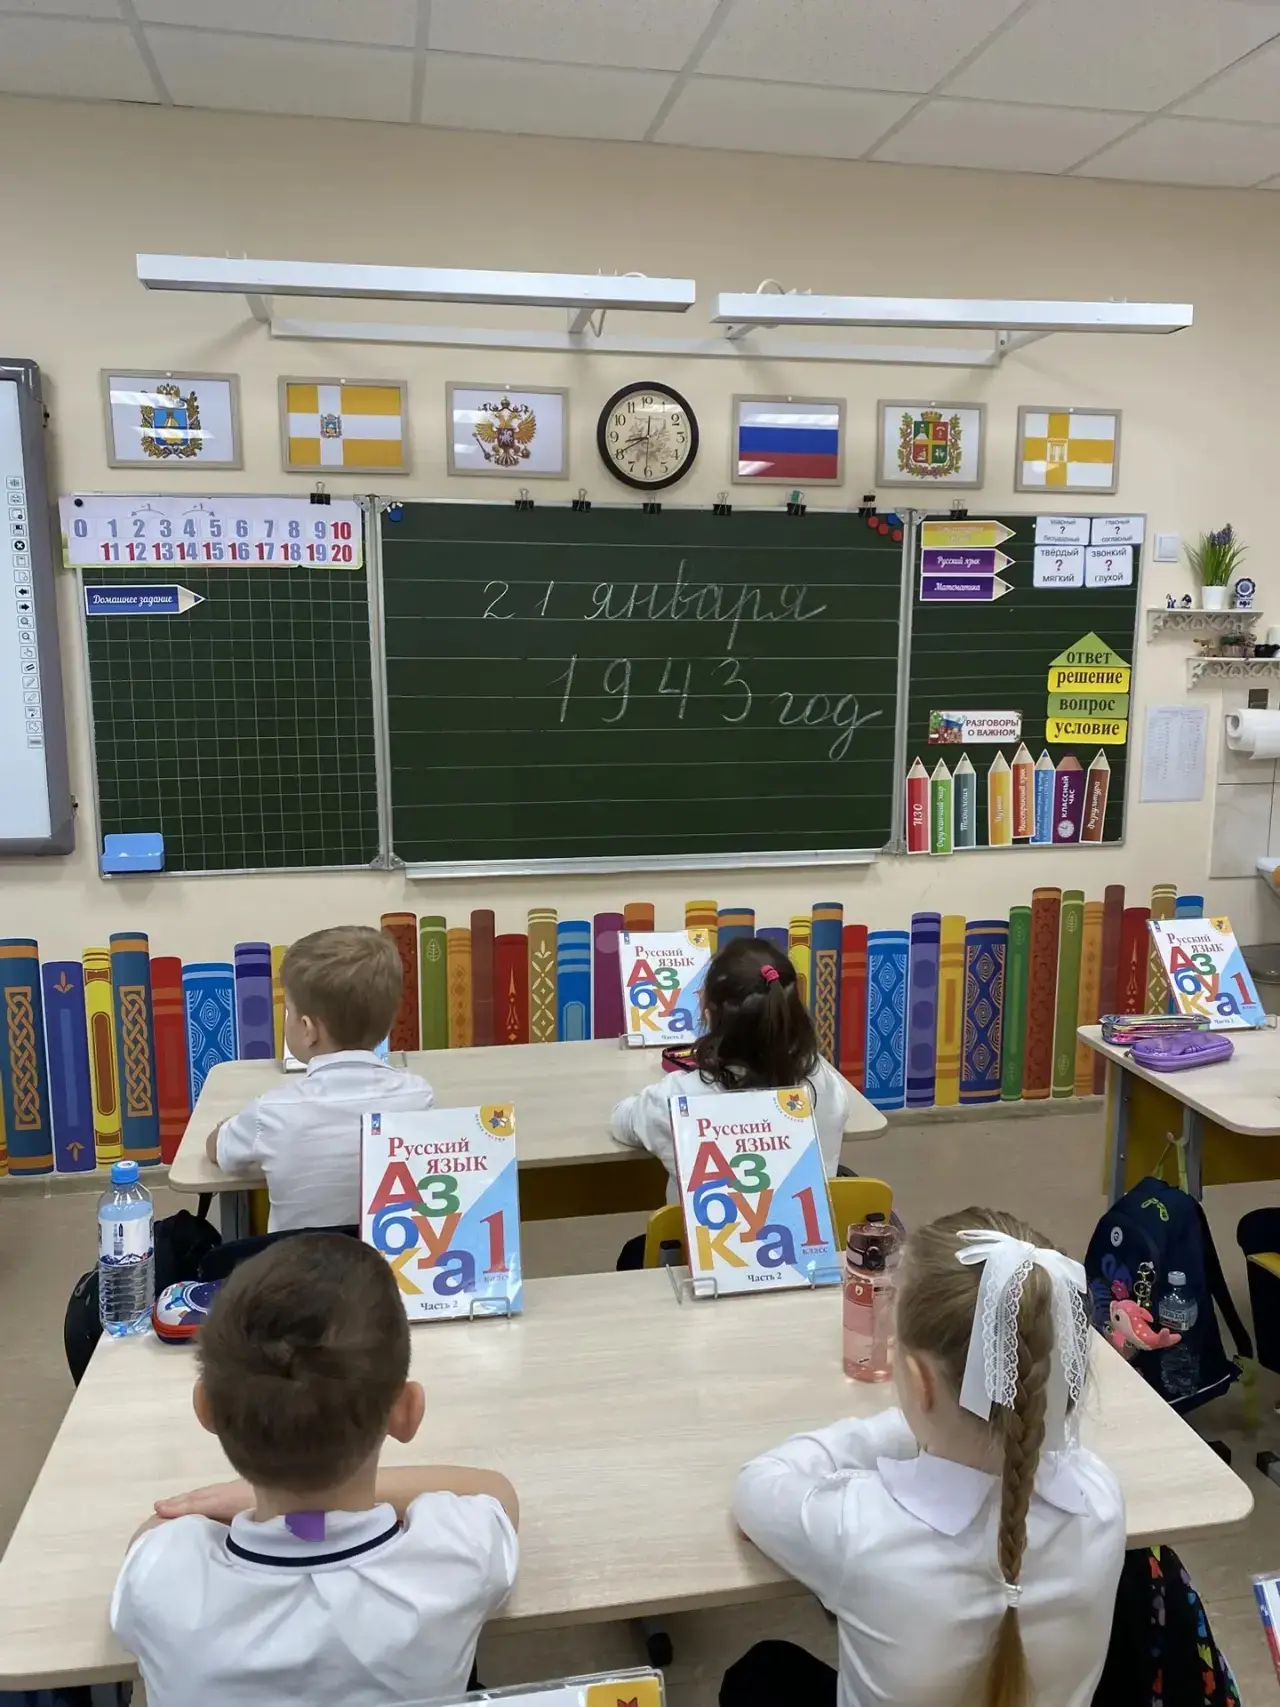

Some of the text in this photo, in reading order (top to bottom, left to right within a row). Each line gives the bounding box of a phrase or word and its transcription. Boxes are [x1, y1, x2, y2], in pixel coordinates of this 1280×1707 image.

[627, 401, 635, 413] 11
[615, 414, 626, 426] 10
[671, 413, 680, 426] 2
[609, 431, 619, 443] 9
[615, 448, 625, 460] 8
[628, 461, 636, 472] 7
[643, 465, 653, 477] 6
[660, 461, 669, 473] 5
[74, 518, 352, 540] 0 1 2 3 4 5 6 7 8 9 10
[100, 542, 353, 562] 11 12 13 14 15 16 17 18 19 20
[1091, 548, 1127, 557] звонкий
[937, 555, 964, 568] Русский
[1055, 559, 1063, 571] ?
[1105, 559, 1113, 571] ?
[1042, 573, 1075, 582] мягкий
[1094, 573, 1123, 583] глухой
[93, 594, 173, 607] Домашнее задание
[584, 558, 827, 650] января
[1066, 651, 1112, 664] ответ
[1056, 669, 1123, 688] решение
[546, 654, 883, 761] 1943 год
[1059, 697, 1116, 714] вопрос
[965, 719, 1019, 727] РАЗГОВОРЫ
[1054, 721, 1120, 738] условие
[1061, 775, 1070, 818] КЛАССНЫЙ
[913, 803, 923, 826] ИЗО
[1167, 932, 1211, 947] Русский
[635, 945, 683, 959] Русский
[1231, 972, 1256, 1005] 1
[696, 1118, 772, 1141] Русский
[387, 1137, 469, 1161] Русский
[791, 1186, 829, 1247] 1
[480, 1210, 509, 1274] 1
[747, 1274, 775, 1282] Часть
